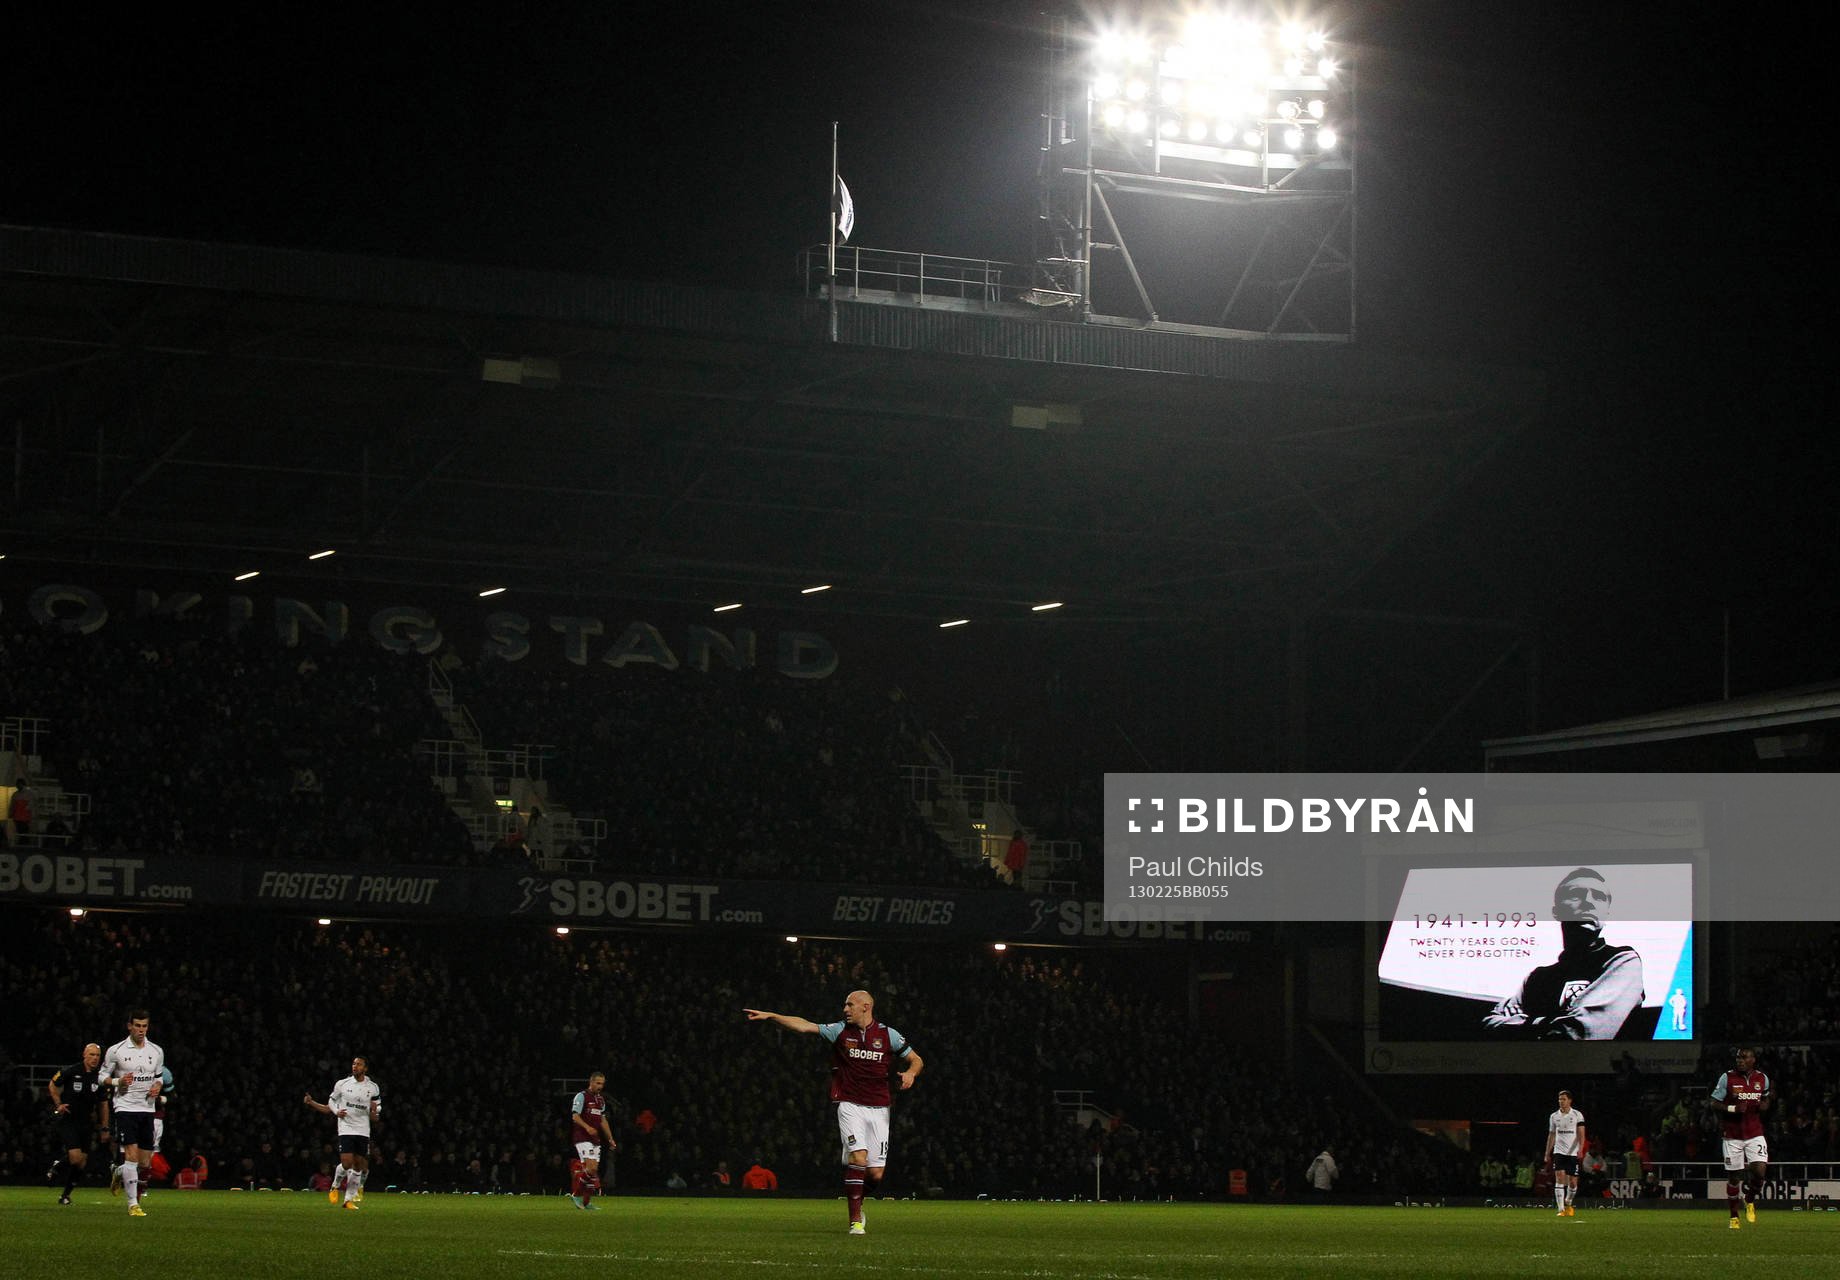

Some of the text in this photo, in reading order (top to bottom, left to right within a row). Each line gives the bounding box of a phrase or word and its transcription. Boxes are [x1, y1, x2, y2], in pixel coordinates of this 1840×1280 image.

[480, 610, 839, 680] STAND
[258, 870, 440, 905] FASTEST PAYOUT
[549, 877, 764, 925] SBOBET.com
[832, 895, 956, 927] BEST PRICES
[1413, 912, 1537, 929] 1941-1993
[1409, 938, 1455, 947] TWENTY
[1460, 937, 1496, 946] YEARS
[1418, 948, 1531, 959] NEVER FORGOTTEN
[849, 1048, 884, 1062] SBOBET
